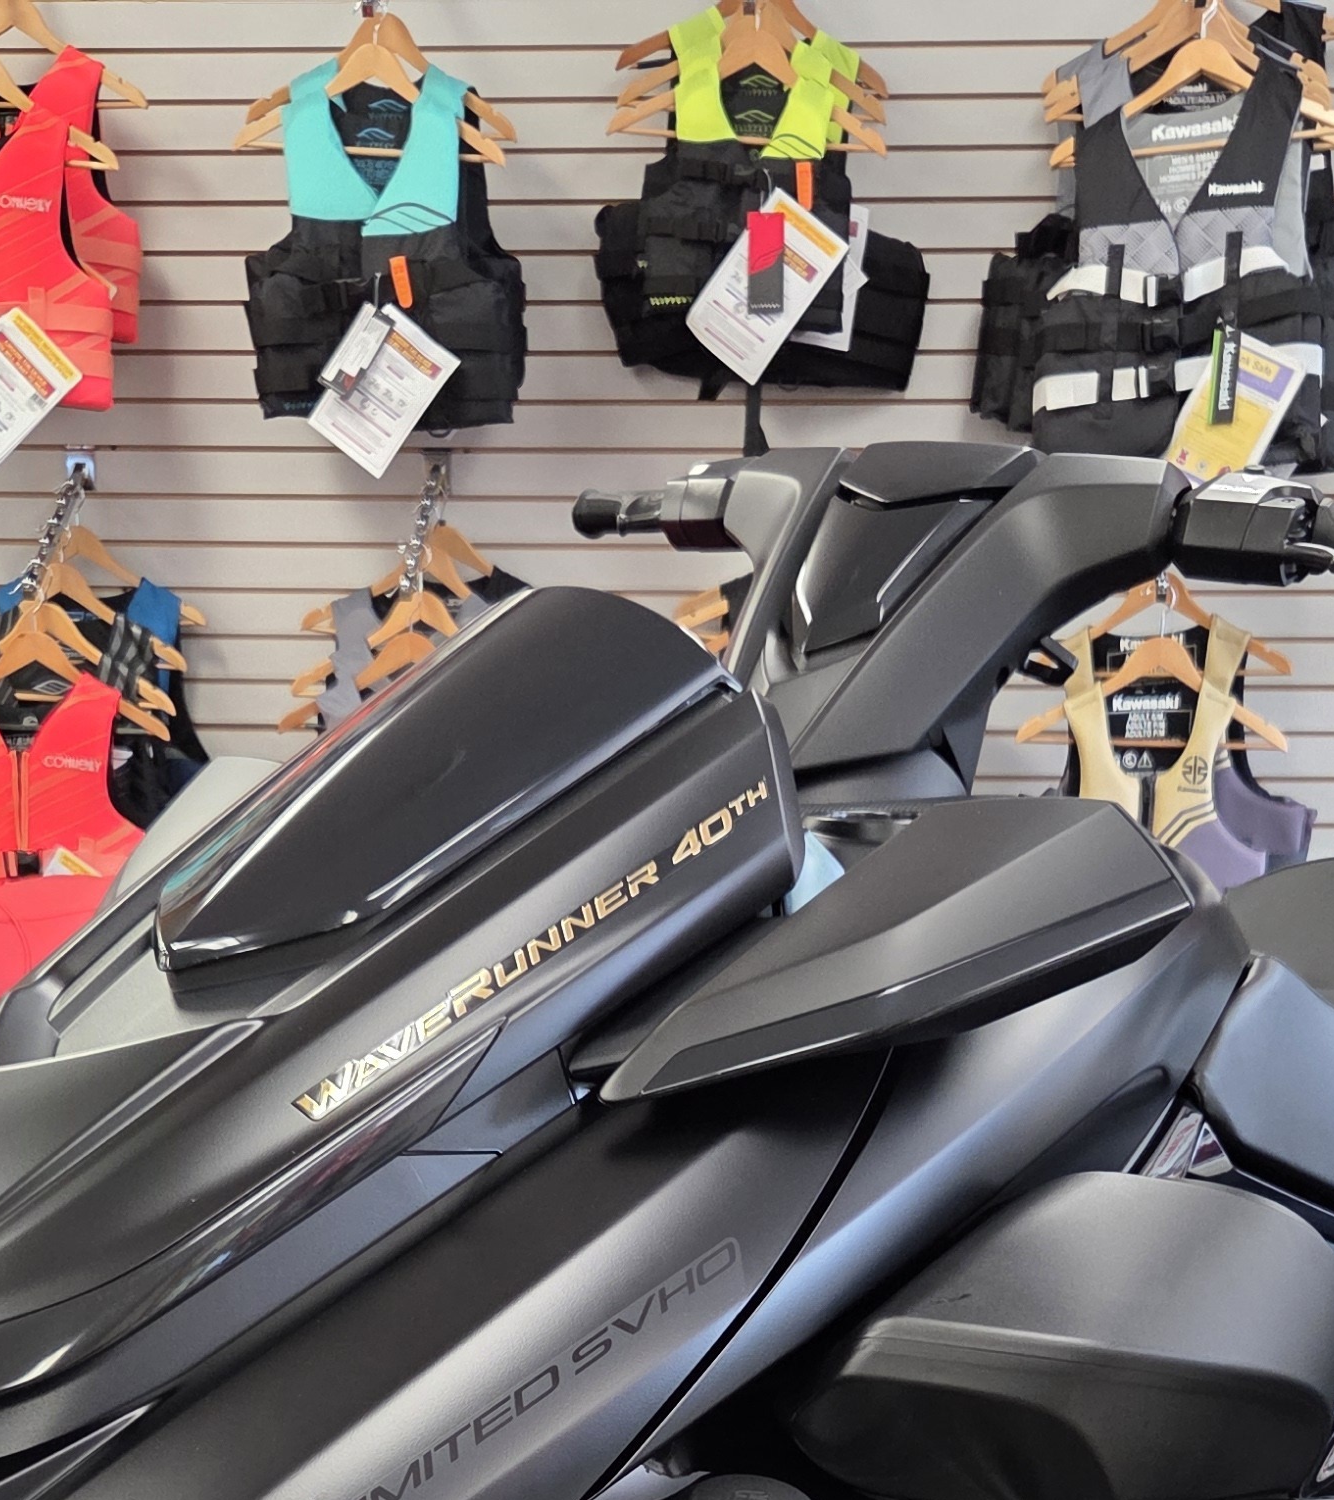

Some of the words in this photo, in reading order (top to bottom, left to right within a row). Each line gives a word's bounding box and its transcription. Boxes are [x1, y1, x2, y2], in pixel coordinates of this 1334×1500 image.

[1208, 180, 1265, 197] Kawasaki
[1112, 690, 1181, 711] Kawasaki
[672, 780, 768, 866] 40TH
[572, 1241, 738, 1376] SVHO
